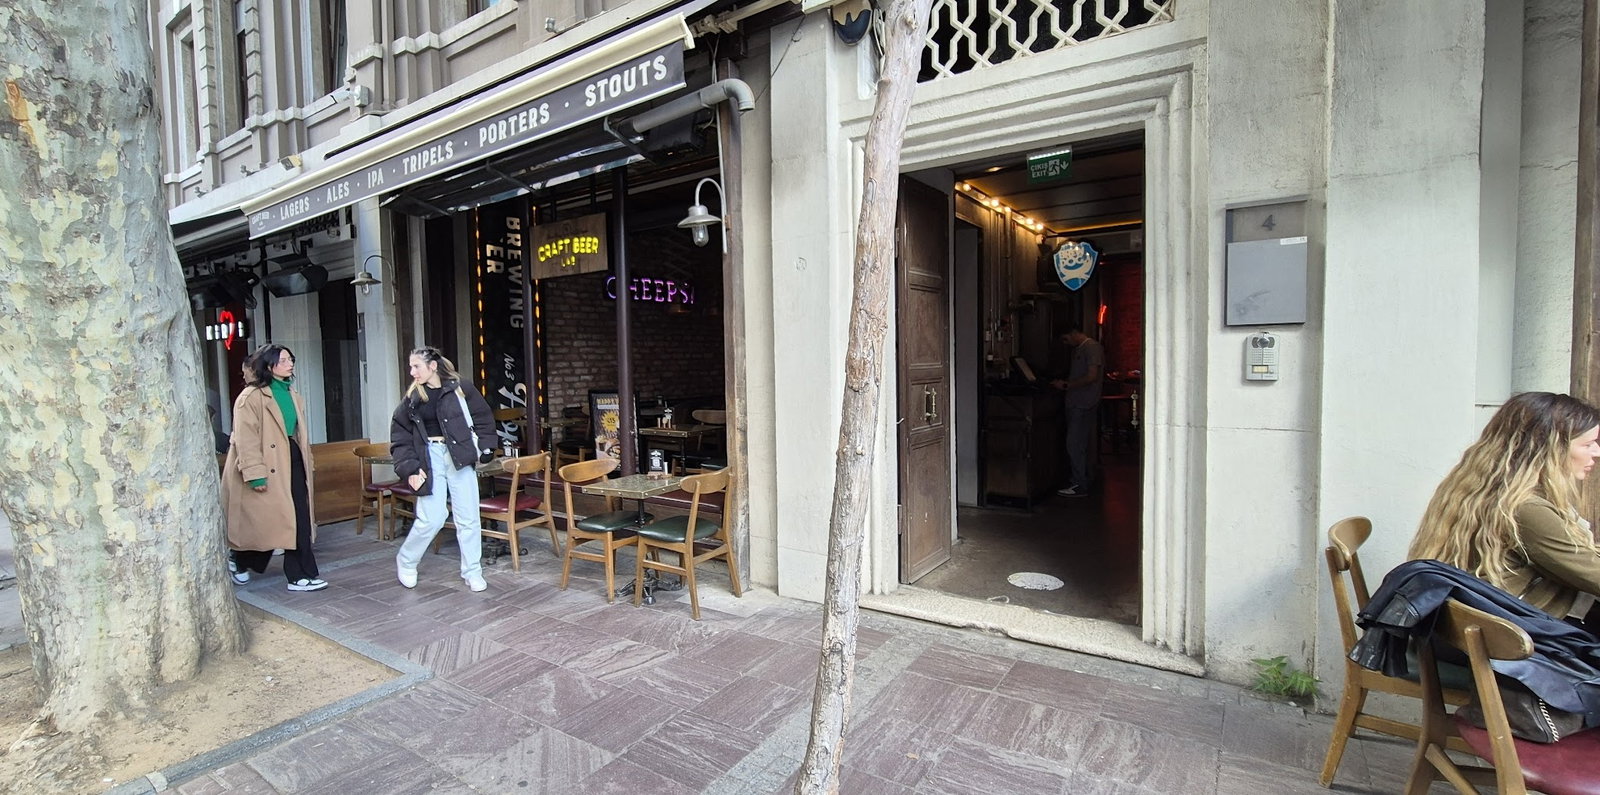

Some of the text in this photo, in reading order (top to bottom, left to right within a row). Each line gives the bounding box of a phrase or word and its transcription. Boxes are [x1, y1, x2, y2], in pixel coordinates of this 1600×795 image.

[280, 54, 668, 221] LAGERS ALES IPA TRIPELS PORTERS STOUTS
[1031, 169, 1047, 178] EXIT
[1261, 214, 1276, 231] 4
[537, 235, 600, 263] CRAFT BEER
[505, 216, 524, 329] BREWING
